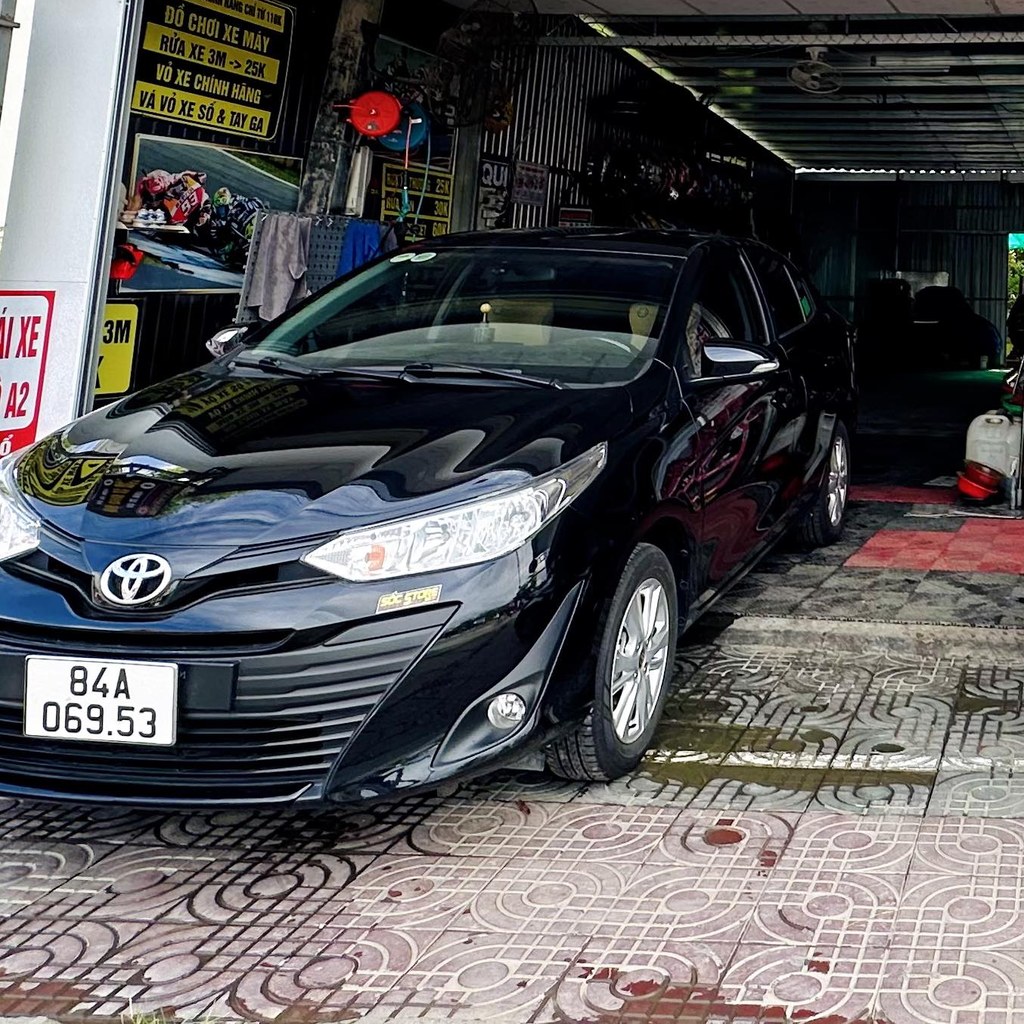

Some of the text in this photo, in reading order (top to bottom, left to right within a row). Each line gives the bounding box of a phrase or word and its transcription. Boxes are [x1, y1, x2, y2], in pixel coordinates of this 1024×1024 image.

[164, 3, 270, 53] ĐỒ CHƠI XE MÁY
[159, 32, 186, 57] RỬA
[189, 43, 206, 61] XE
[208, 48, 228, 67] 3M
[245, 59, 267, 79] 25K
[156, 61, 173, 83] VỎ
[174, 68, 192, 87] XE
[193, 73, 230, 97] CHÍNH
[139, 89, 264, 132] VÁ VỎ XE SỐ & TAY GA
[15, 316, 42, 358] XE
[102, 320, 132, 344] 3M
[4, 382, 30, 418] A2
[69, 664, 131, 700] 84A
[42, 702, 157, 739] 069.53
